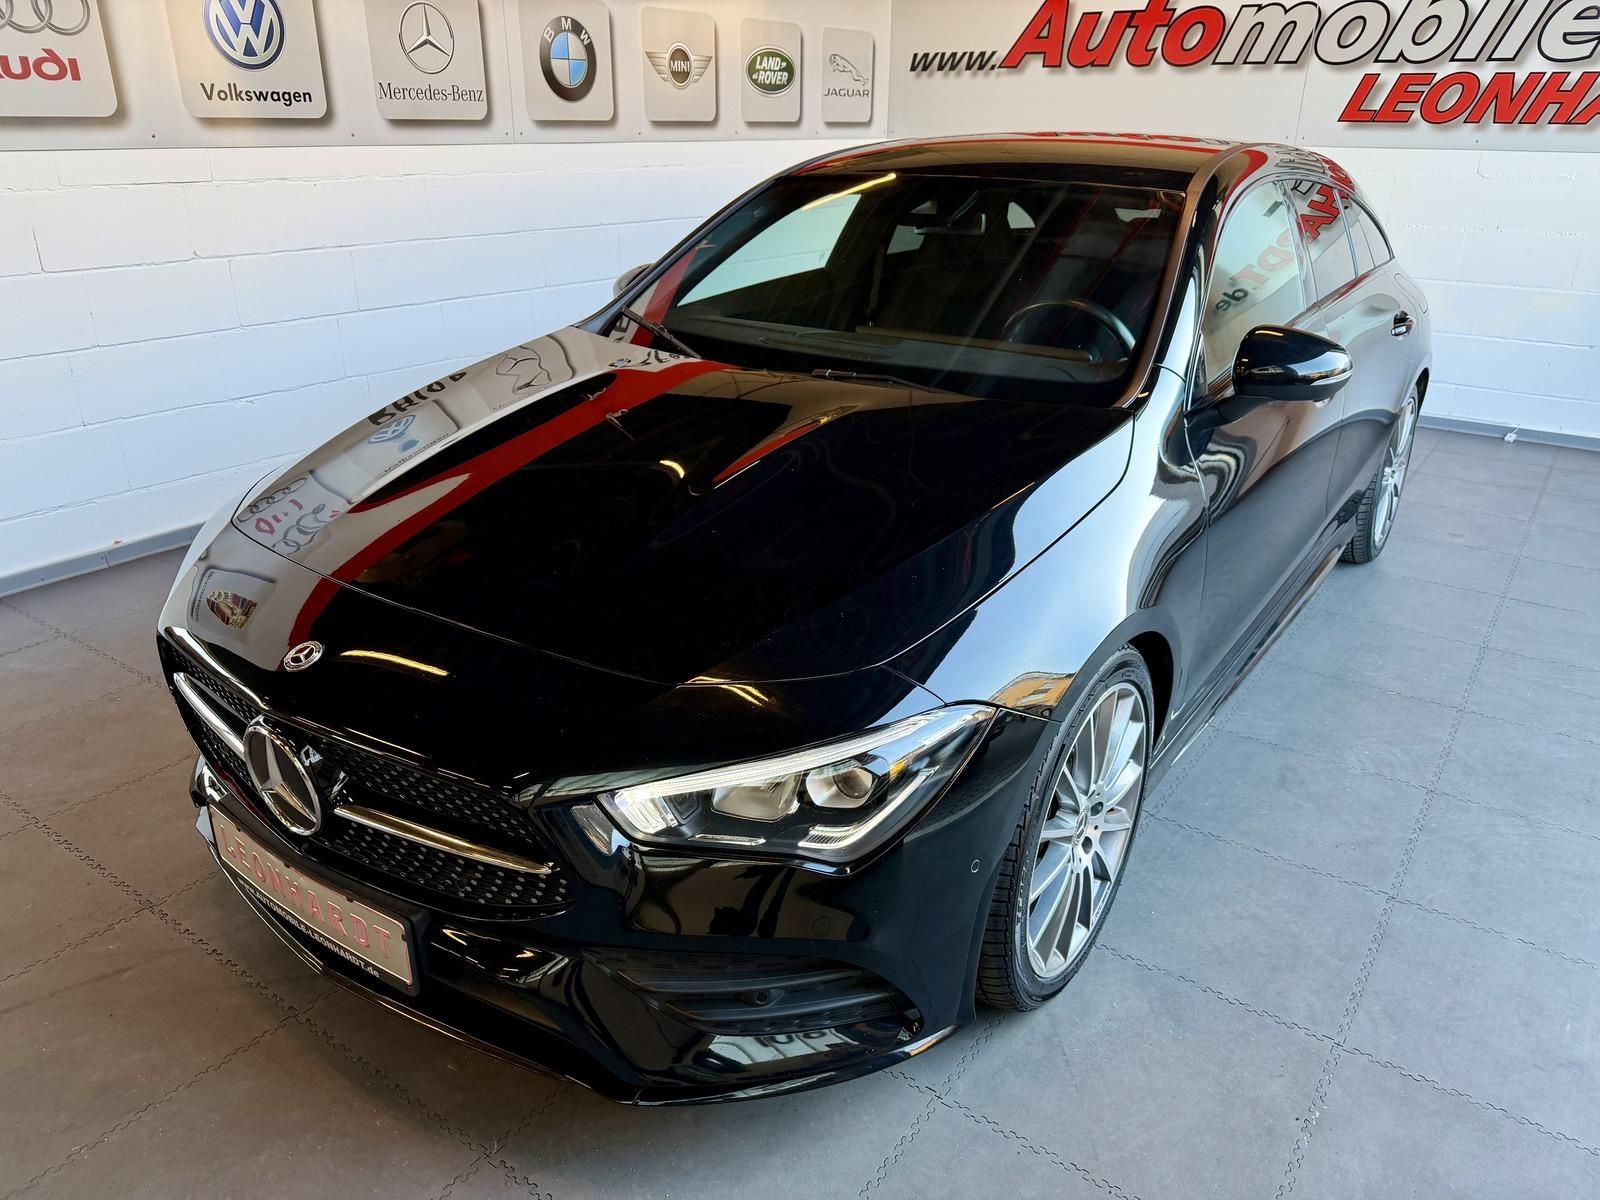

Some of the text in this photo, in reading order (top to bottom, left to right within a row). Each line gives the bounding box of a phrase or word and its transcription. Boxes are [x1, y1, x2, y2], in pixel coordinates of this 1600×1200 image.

[543, 17, 591, 45] BMW
[0, 48, 81, 81] udi
[670, 60, 690, 73] MINI
[755, 56, 781, 71] LAND
[757, 70, 789, 85] ROVER
[200, 82, 312, 107] Volkswagen
[378, 81, 484, 102] Mercedes-Benz
[823, 87, 870, 98] JAGUAR
[220, 823, 391, 960] LEONHARDT
